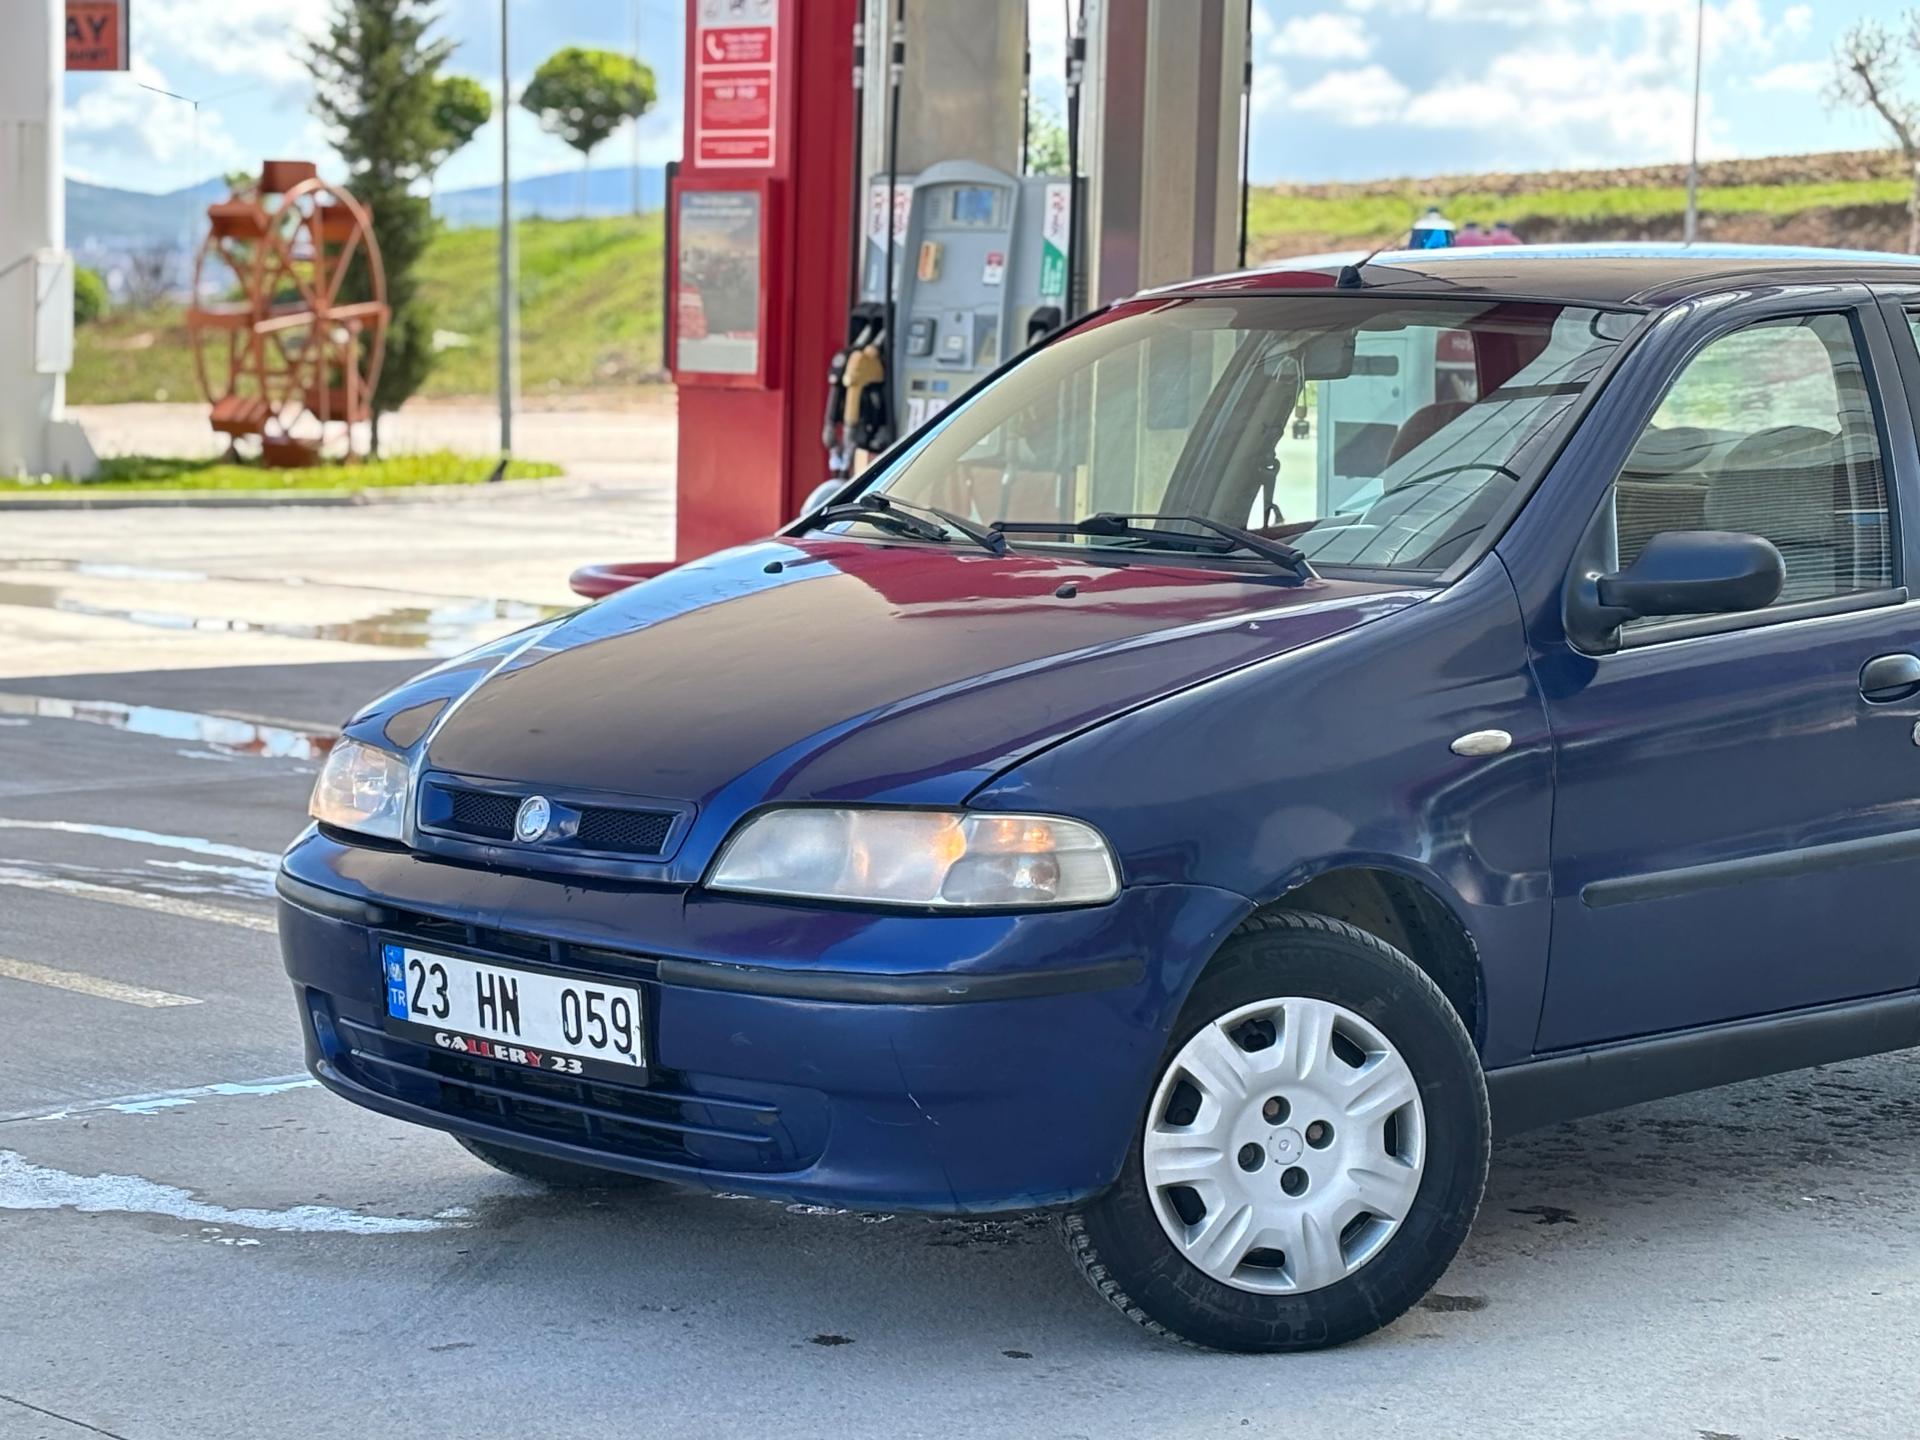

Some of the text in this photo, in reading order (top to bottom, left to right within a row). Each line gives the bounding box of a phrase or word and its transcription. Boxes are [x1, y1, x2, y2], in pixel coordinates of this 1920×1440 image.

[390, 988, 406, 1007] TR
[409, 959, 633, 1054] 23 HN 059
[435, 1032, 583, 1074] GALLERY 23
